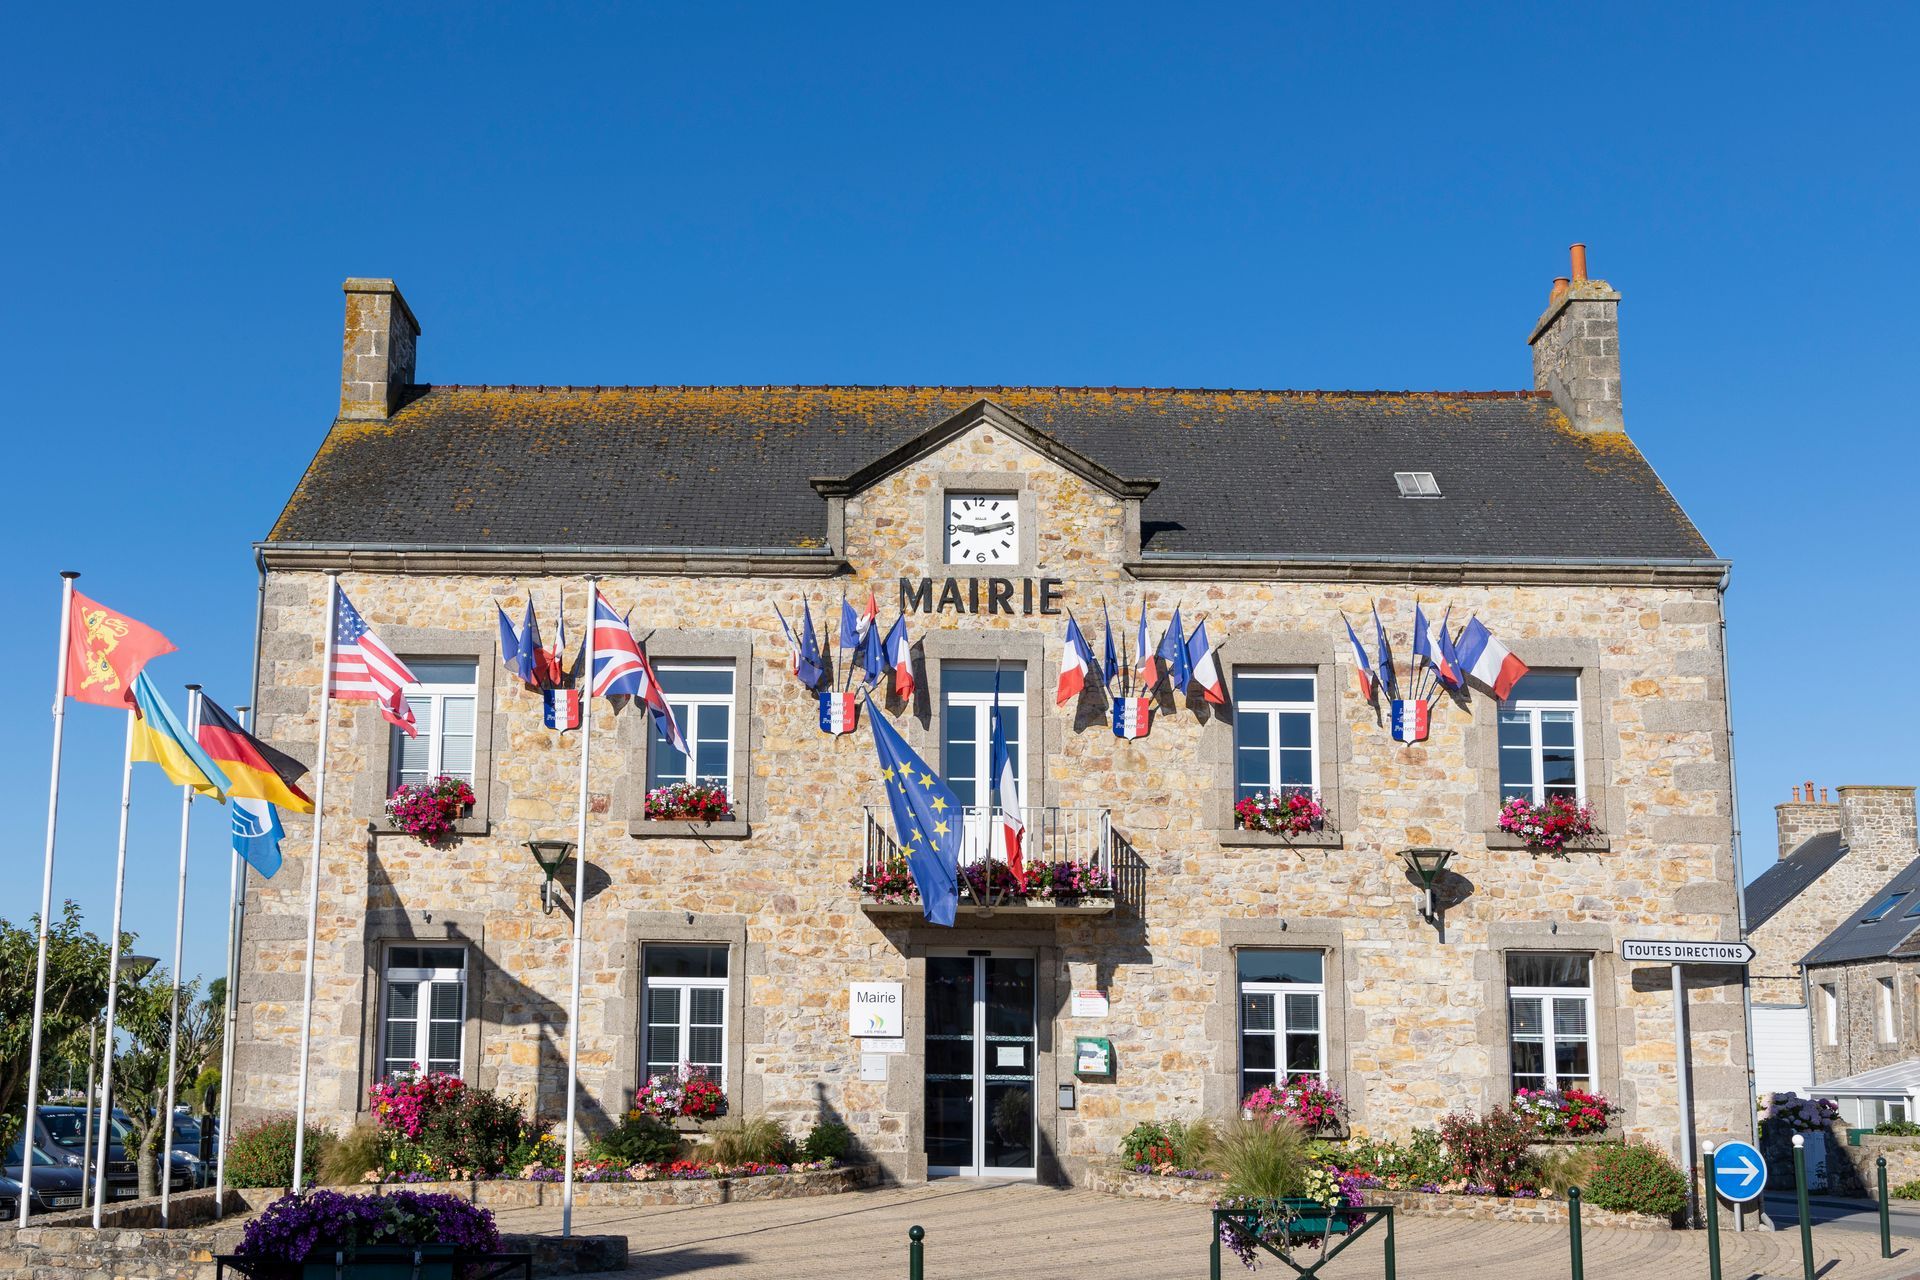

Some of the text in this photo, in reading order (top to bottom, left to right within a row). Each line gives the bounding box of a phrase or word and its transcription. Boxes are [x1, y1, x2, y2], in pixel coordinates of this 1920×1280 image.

[973, 497, 985, 507] 12
[947, 524, 957, 535] 9
[1006, 525, 1015, 535] 3
[976, 552, 986, 563] 6
[900, 577, 1063, 614] MAIRIE
[1628, 945, 1743, 958] TOUTES DIRECTIONS
[857, 991, 896, 1003] Mairie
